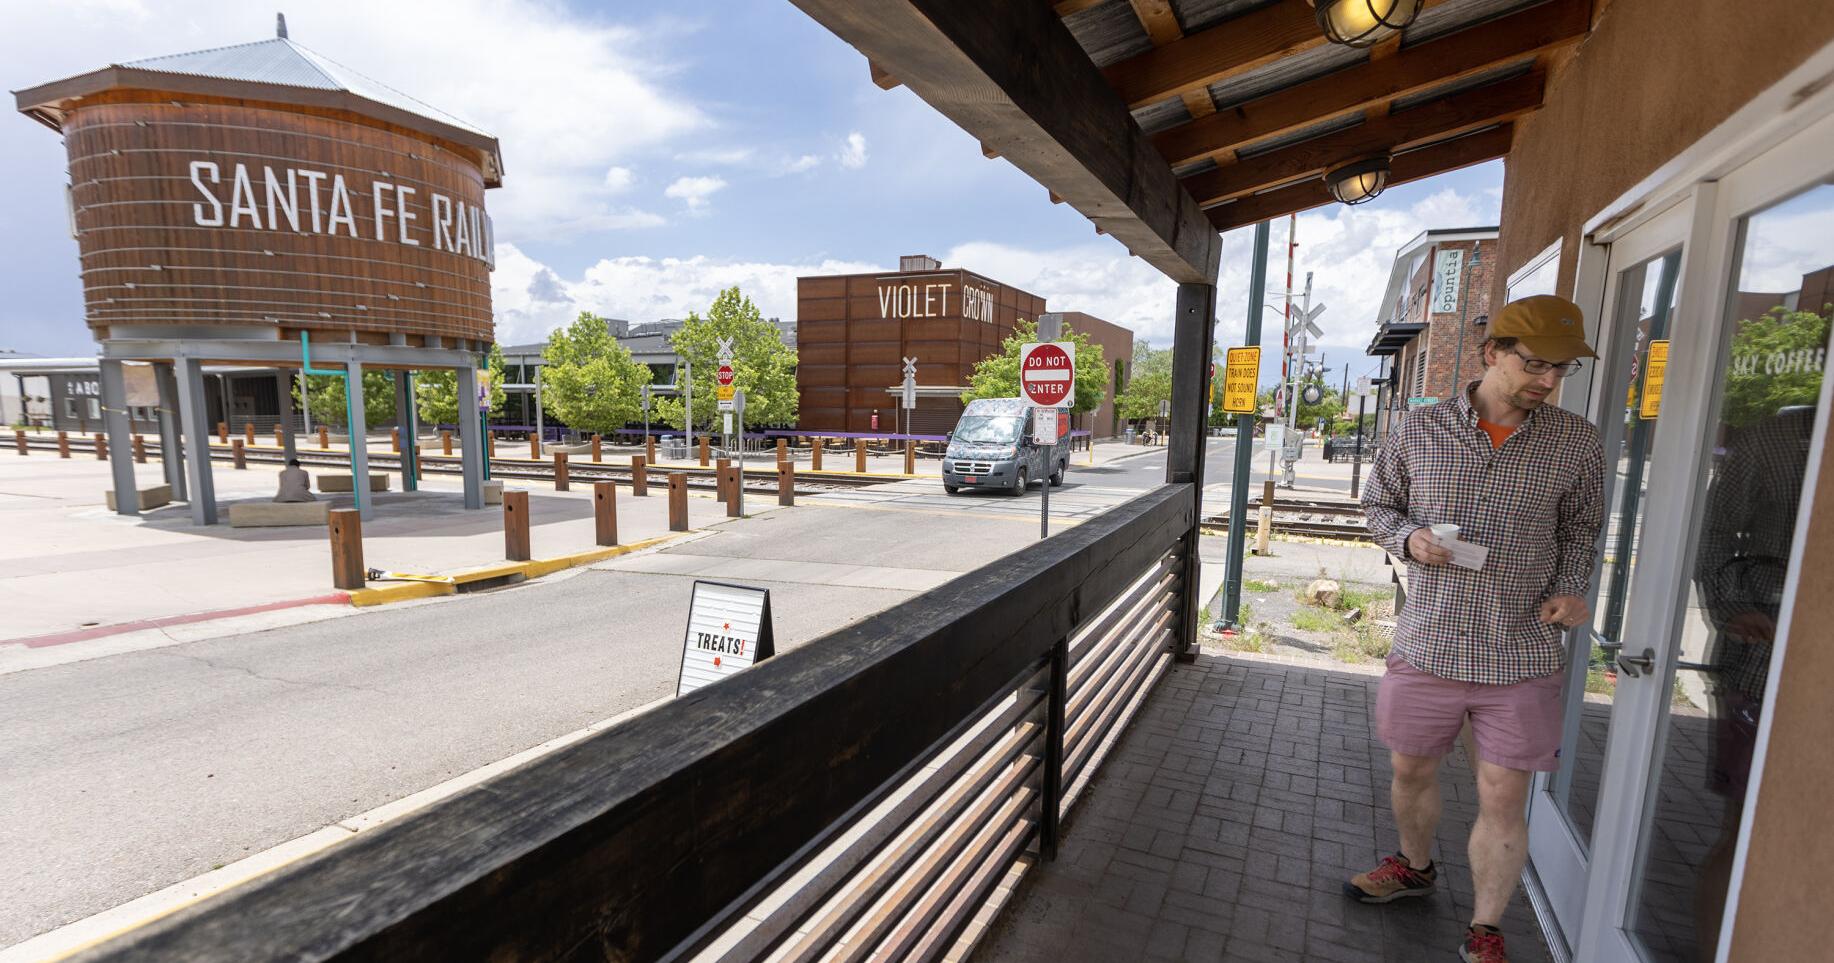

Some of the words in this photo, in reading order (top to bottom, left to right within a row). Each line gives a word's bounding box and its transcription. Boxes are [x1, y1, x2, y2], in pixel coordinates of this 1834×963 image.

[189, 160, 358, 238] SANTA
[372, 181, 420, 246] FE
[1443, 251, 1459, 312] opuntia
[878, 283, 952, 319] VIOLET
[963, 284, 994, 324] CROWN
[1029, 356, 1042, 367] DO
[1046, 355, 1066, 367] NOT
[1765, 347, 1825, 375] COFFEE
[718, 371, 733, 380] STOP
[1228, 368, 1243, 378] TRAIN
[1243, 367, 1256, 378] DOES
[1031, 383, 1064, 394] ENTER
[1227, 383, 1237, 393] NOT
[1237, 383, 1254, 393] SOUND
[697, 632, 746, 656] TREATS!
